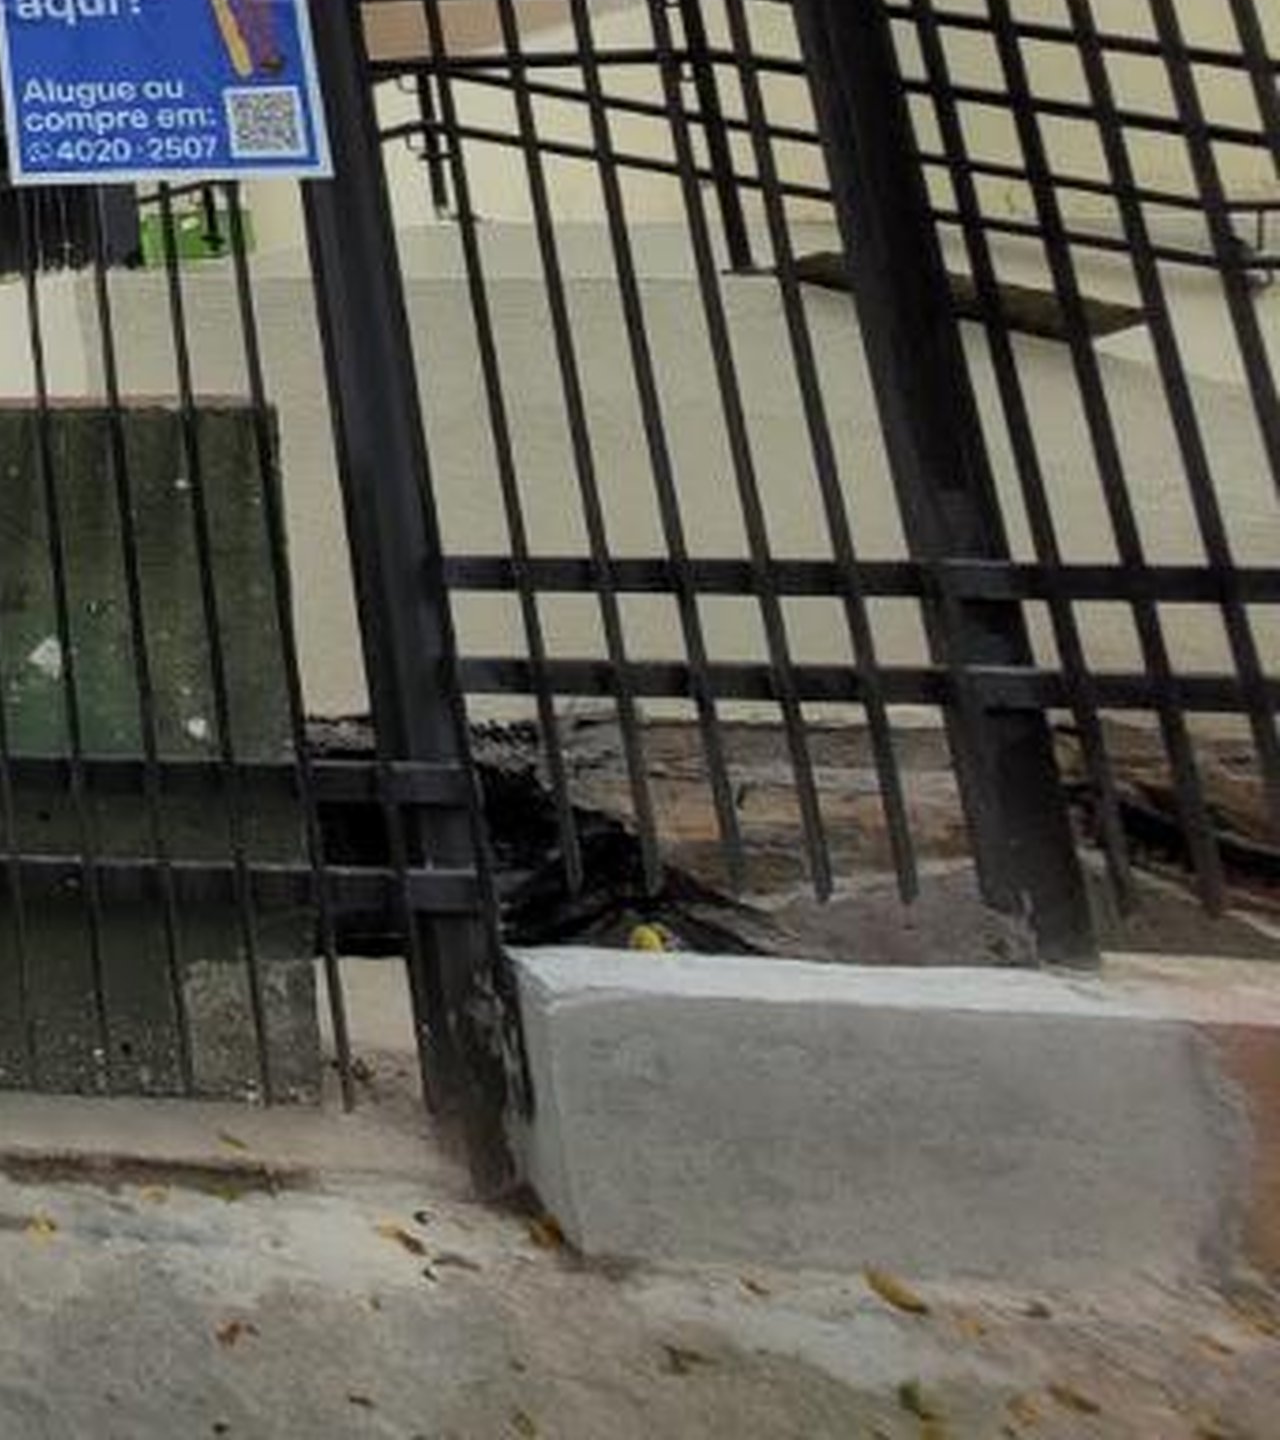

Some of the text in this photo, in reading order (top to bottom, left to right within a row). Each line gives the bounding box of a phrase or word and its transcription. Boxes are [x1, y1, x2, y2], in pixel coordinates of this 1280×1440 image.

[23, 78, 184, 109] Alugue ou
[23, 108, 149, 136] compre
